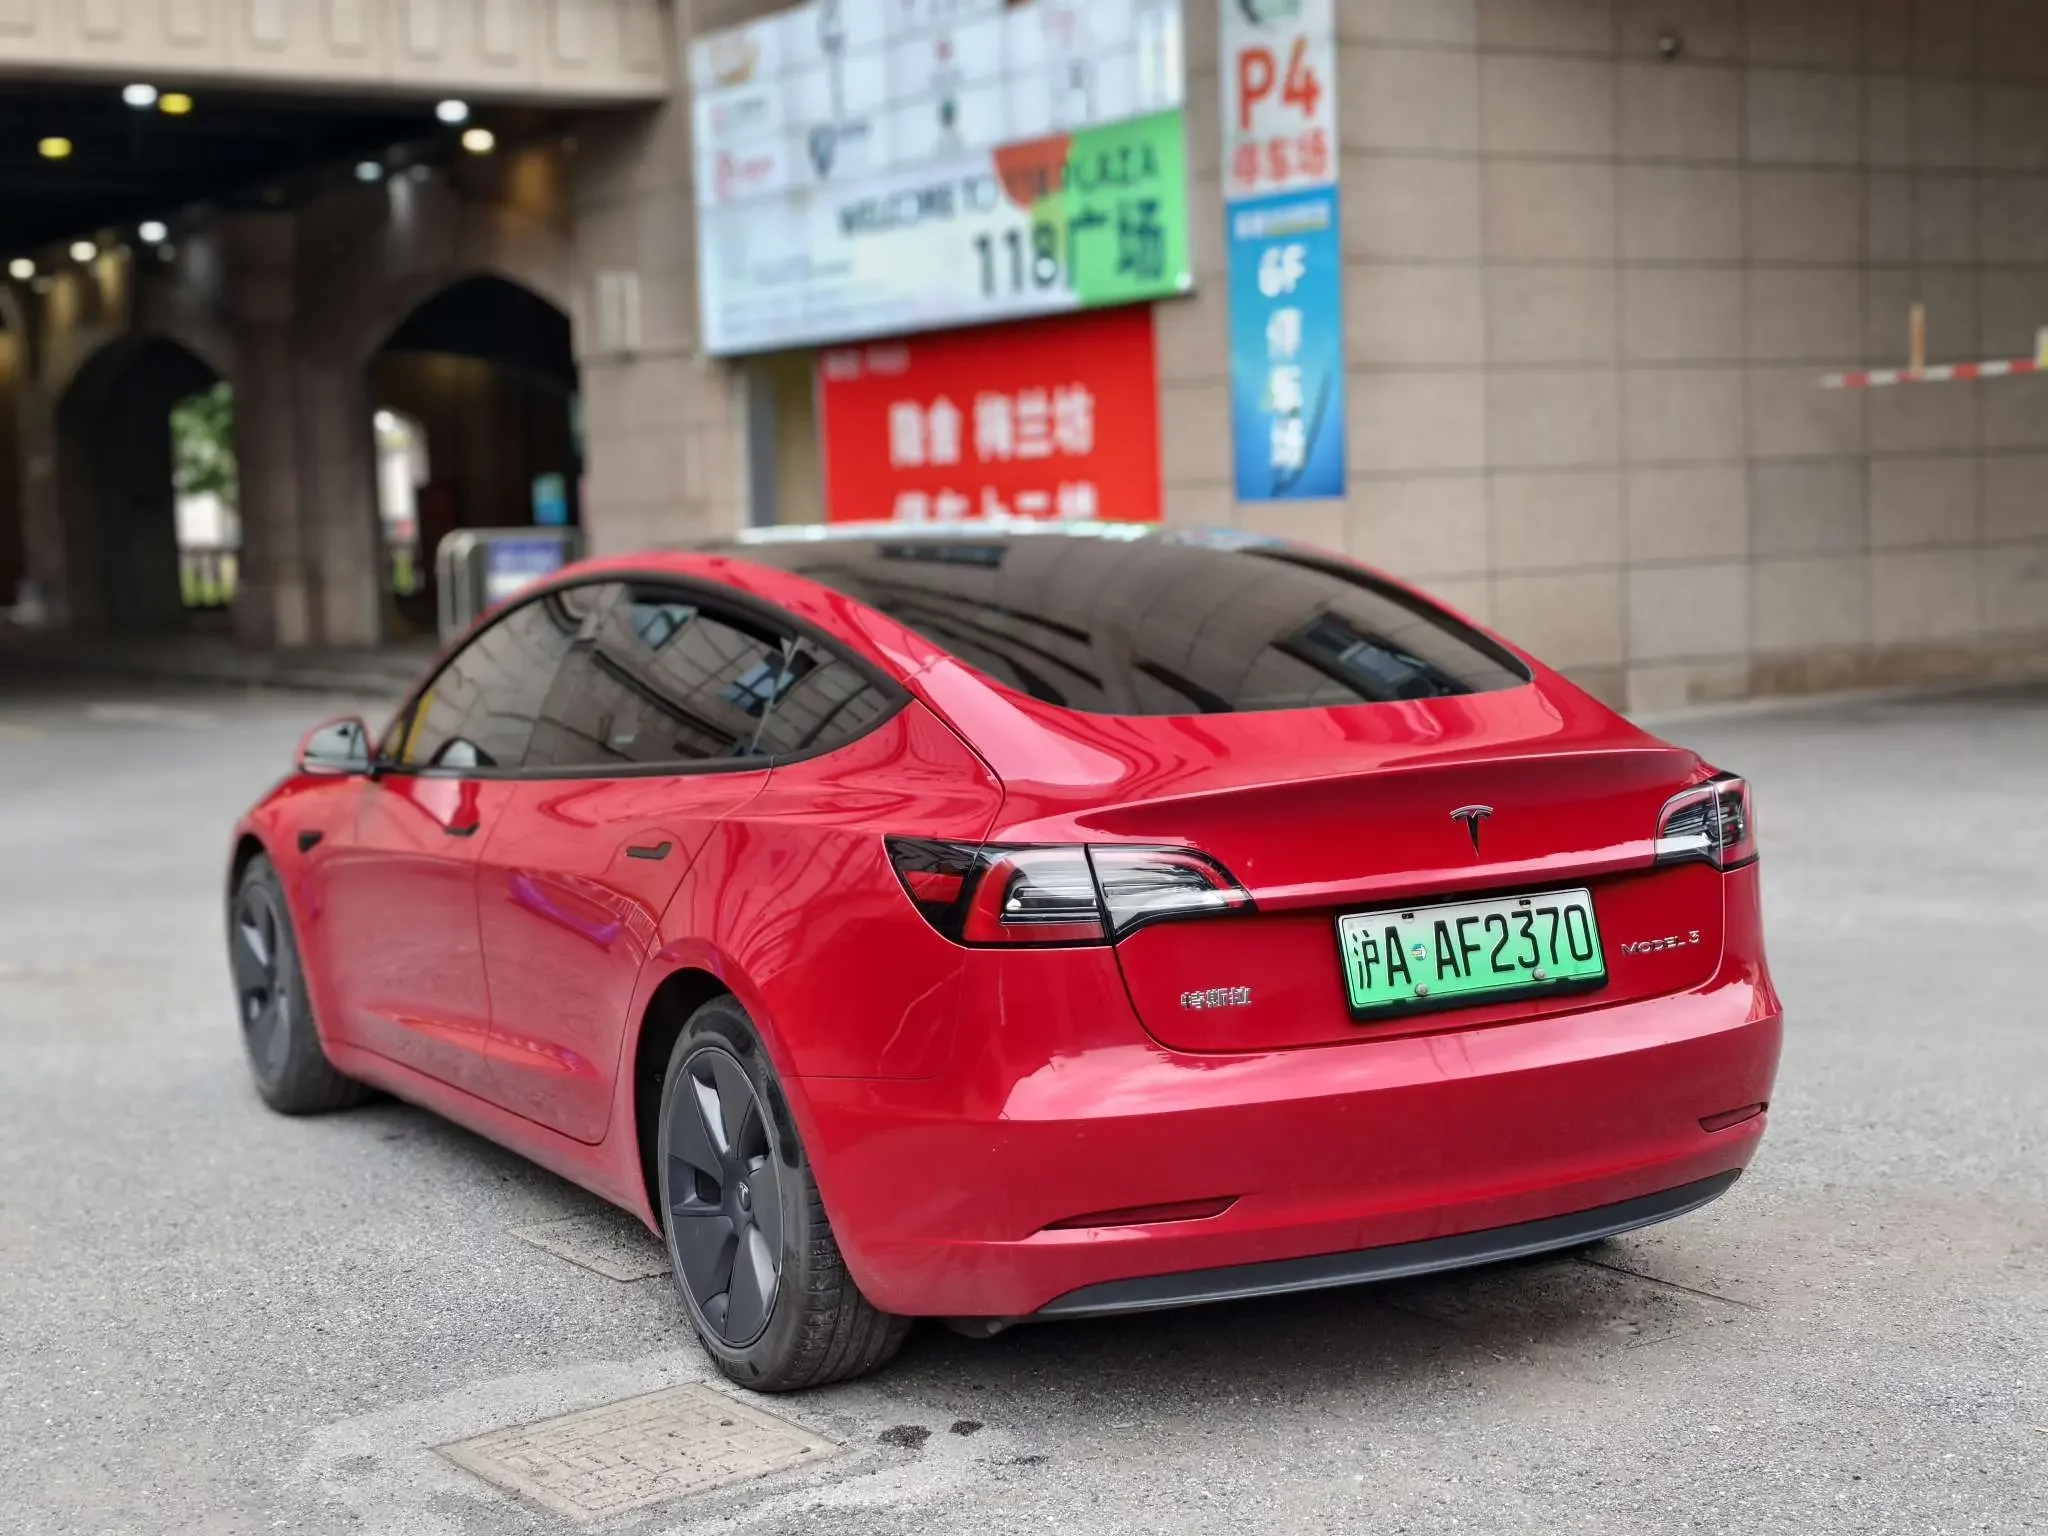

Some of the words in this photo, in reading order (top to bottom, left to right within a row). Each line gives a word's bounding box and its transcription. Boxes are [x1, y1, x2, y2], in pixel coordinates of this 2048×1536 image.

[1237, 35, 1323, 131] P4
[1231, 130, 1327, 183] 停车场
[841, 186, 954, 234] WELCOME
[962, 174, 998, 213] TO
[1258, 244, 1307, 297] 6F
[1352, 926, 1412, 990] 沪A
[1433, 904, 1594, 981] AF2370
[1621, 935, 1687, 956] MODEL
[1688, 930, 1700, 943] 3
[1180, 986, 1252, 1010] 特斯拉
